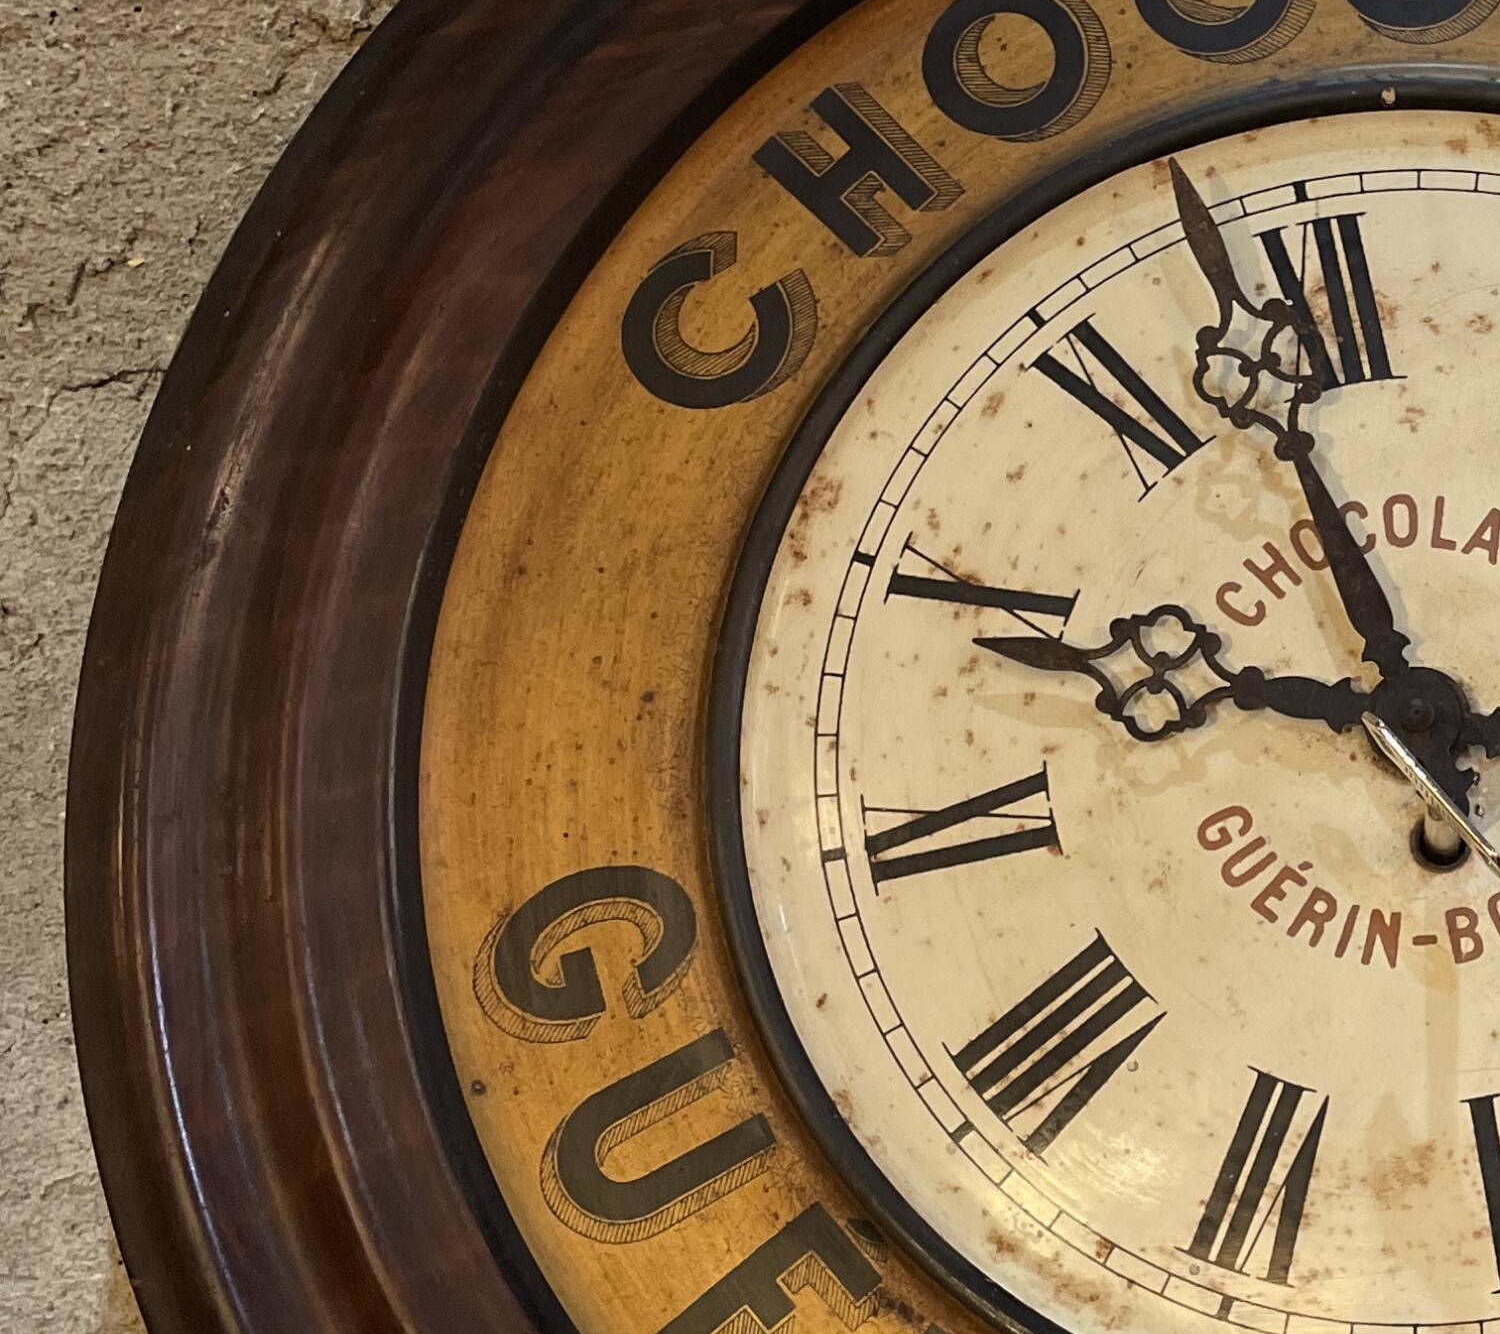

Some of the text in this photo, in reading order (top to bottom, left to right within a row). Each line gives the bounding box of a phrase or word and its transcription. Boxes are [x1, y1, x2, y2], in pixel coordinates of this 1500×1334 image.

[1252, 212, 1408, 402] XII
[1026, 313, 1217, 503] XI
[884, 534, 1081, 641] X
[860, 760, 1065, 897] IX
[941, 928, 1168, 1164] VIII
[1172, 1065, 1331, 1288] VII
